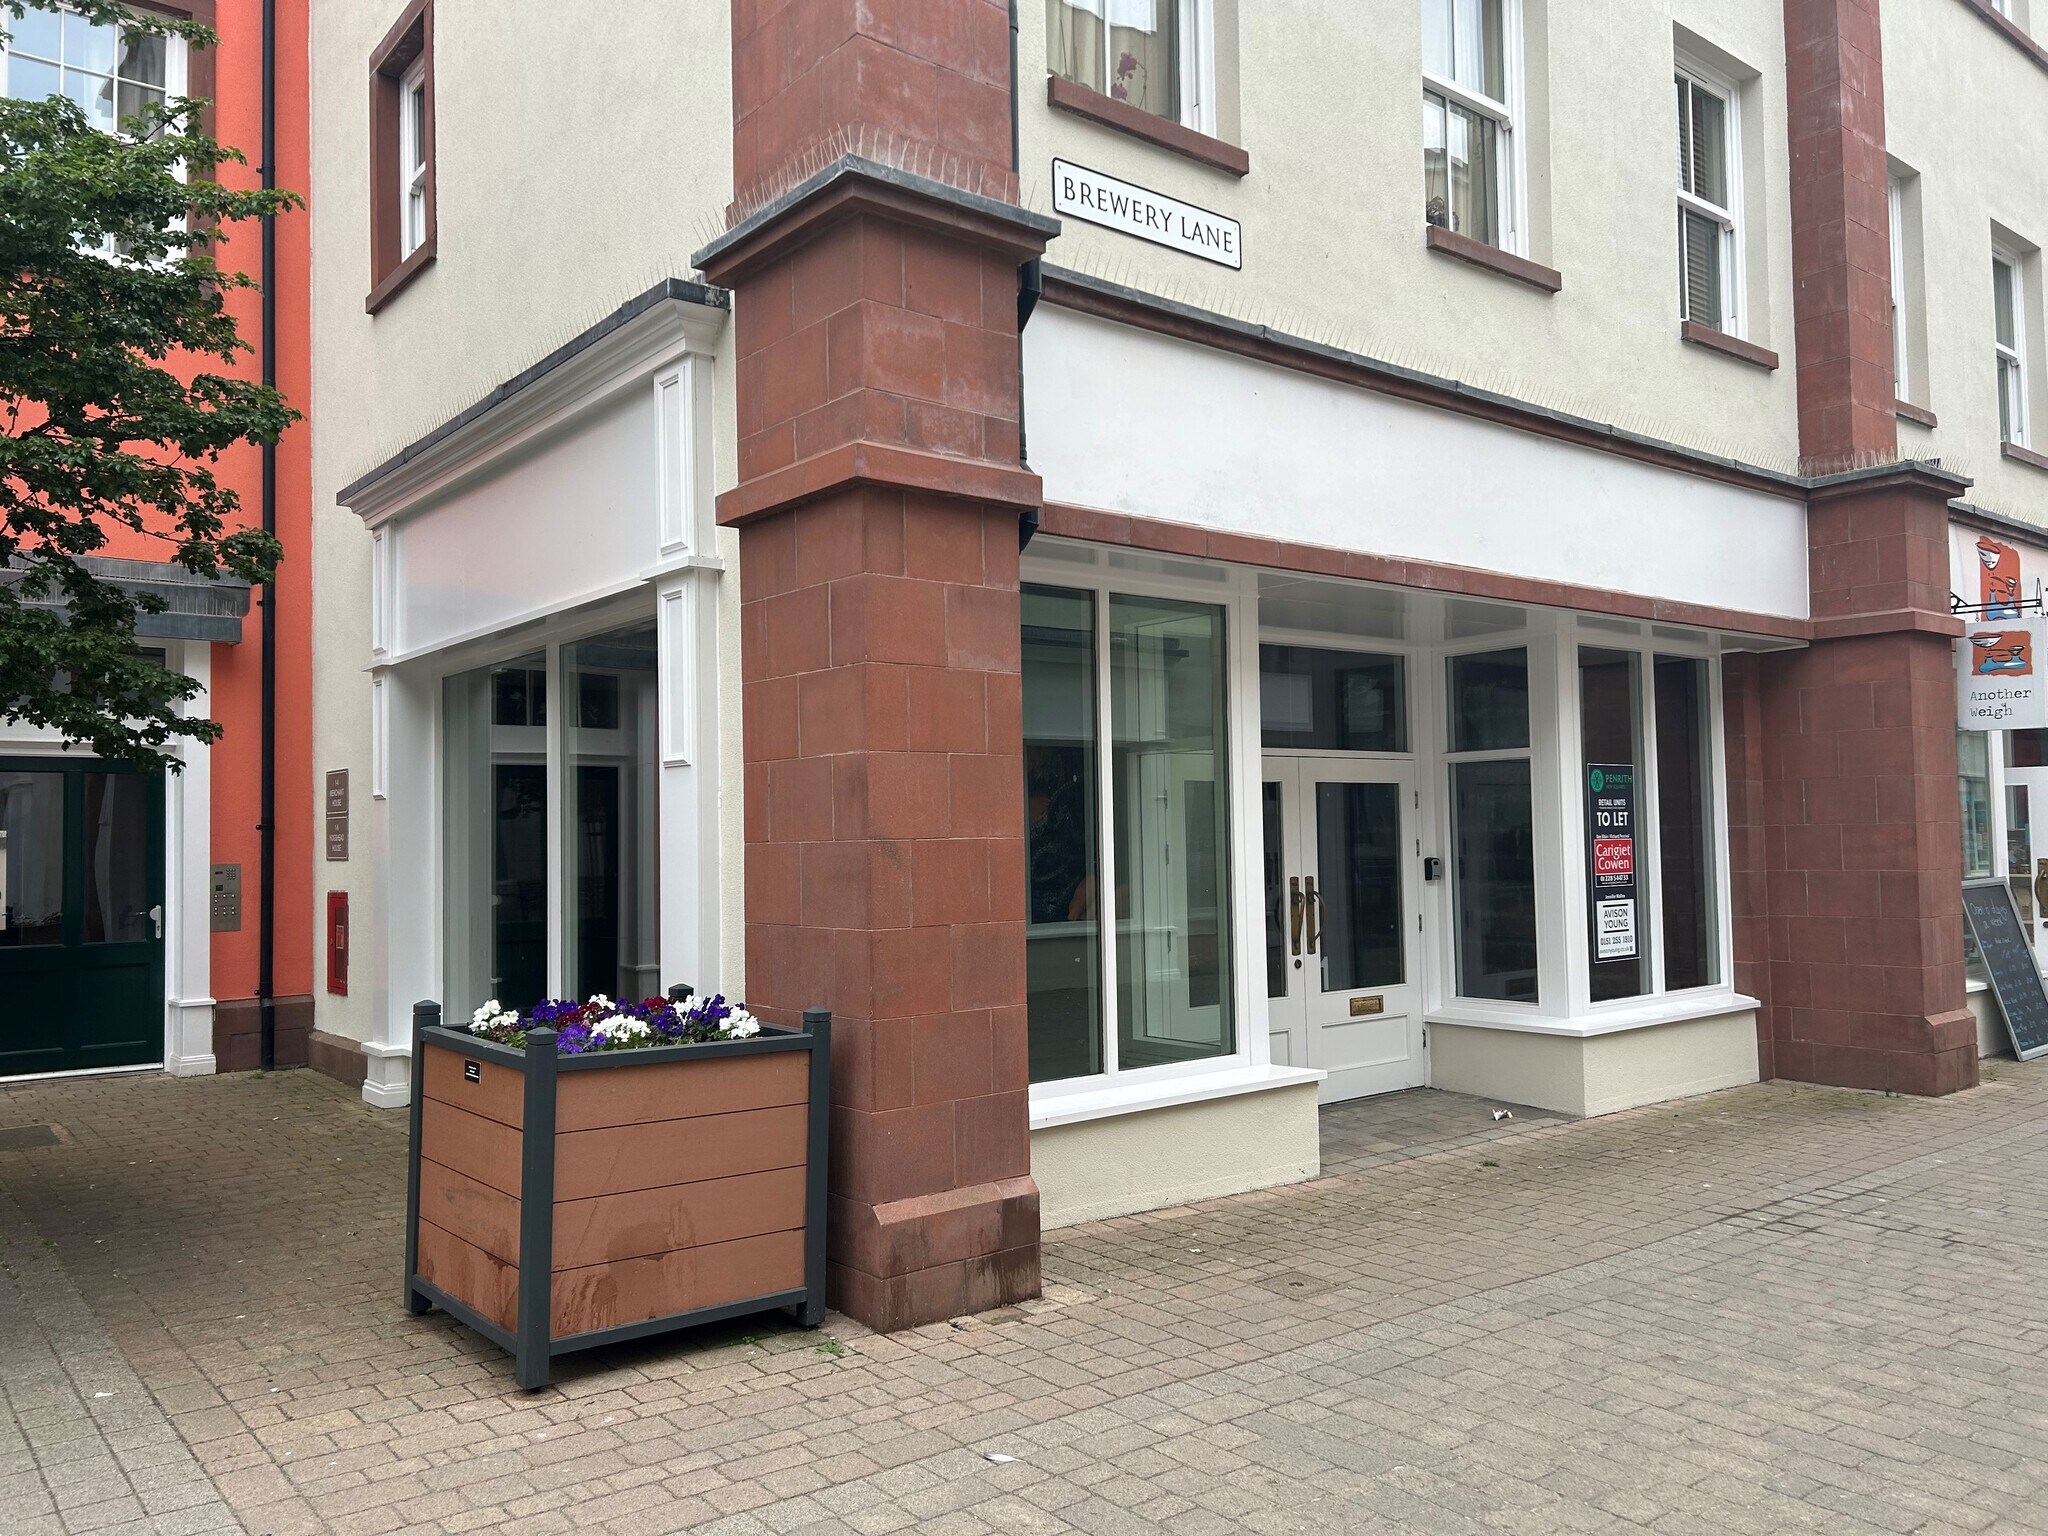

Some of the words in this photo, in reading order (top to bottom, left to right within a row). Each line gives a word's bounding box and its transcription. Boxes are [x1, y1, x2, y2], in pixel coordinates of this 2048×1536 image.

[1063, 176, 1172, 232] BREWERY
[1181, 216, 1233, 253] LANE
[1970, 688, 2032, 701] Another
[1970, 704, 2014, 720] Weigh
[1605, 774, 1633, 784] PENRITH
[1596, 812, 1611, 827] TO
[1613, 812, 1629, 826] LET
[1596, 844, 1631, 860] Carigiet
[1598, 857, 1630, 870] Cowen
[1603, 908, 1628, 918] AVISON
[1604, 919, 1629, 929] YOUNG
[1612, 936, 1621, 944] 255
